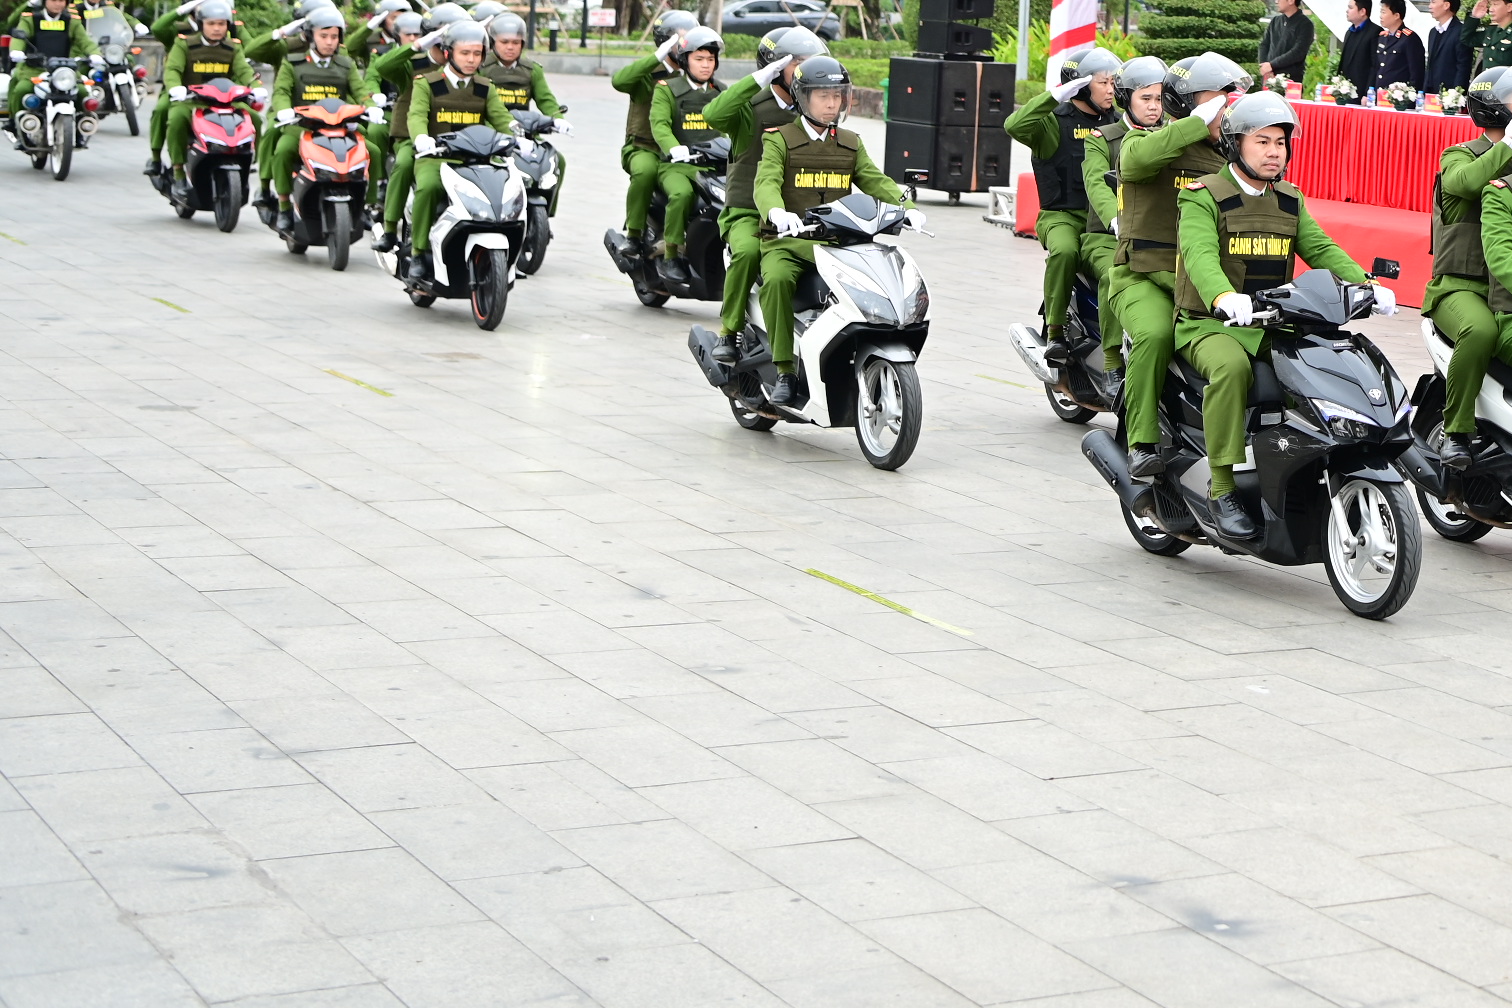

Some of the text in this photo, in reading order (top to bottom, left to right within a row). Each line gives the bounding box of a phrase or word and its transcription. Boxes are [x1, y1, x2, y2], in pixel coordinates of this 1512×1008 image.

[760, 37, 777, 51] SHS
[1064, 60, 1079, 70] SHS
[795, 168, 814, 188] CẢNH
[814, 170, 827, 188] SÁT
[1228, 231, 1252, 255] CẢNH
[1252, 234, 1267, 256] SÁT
